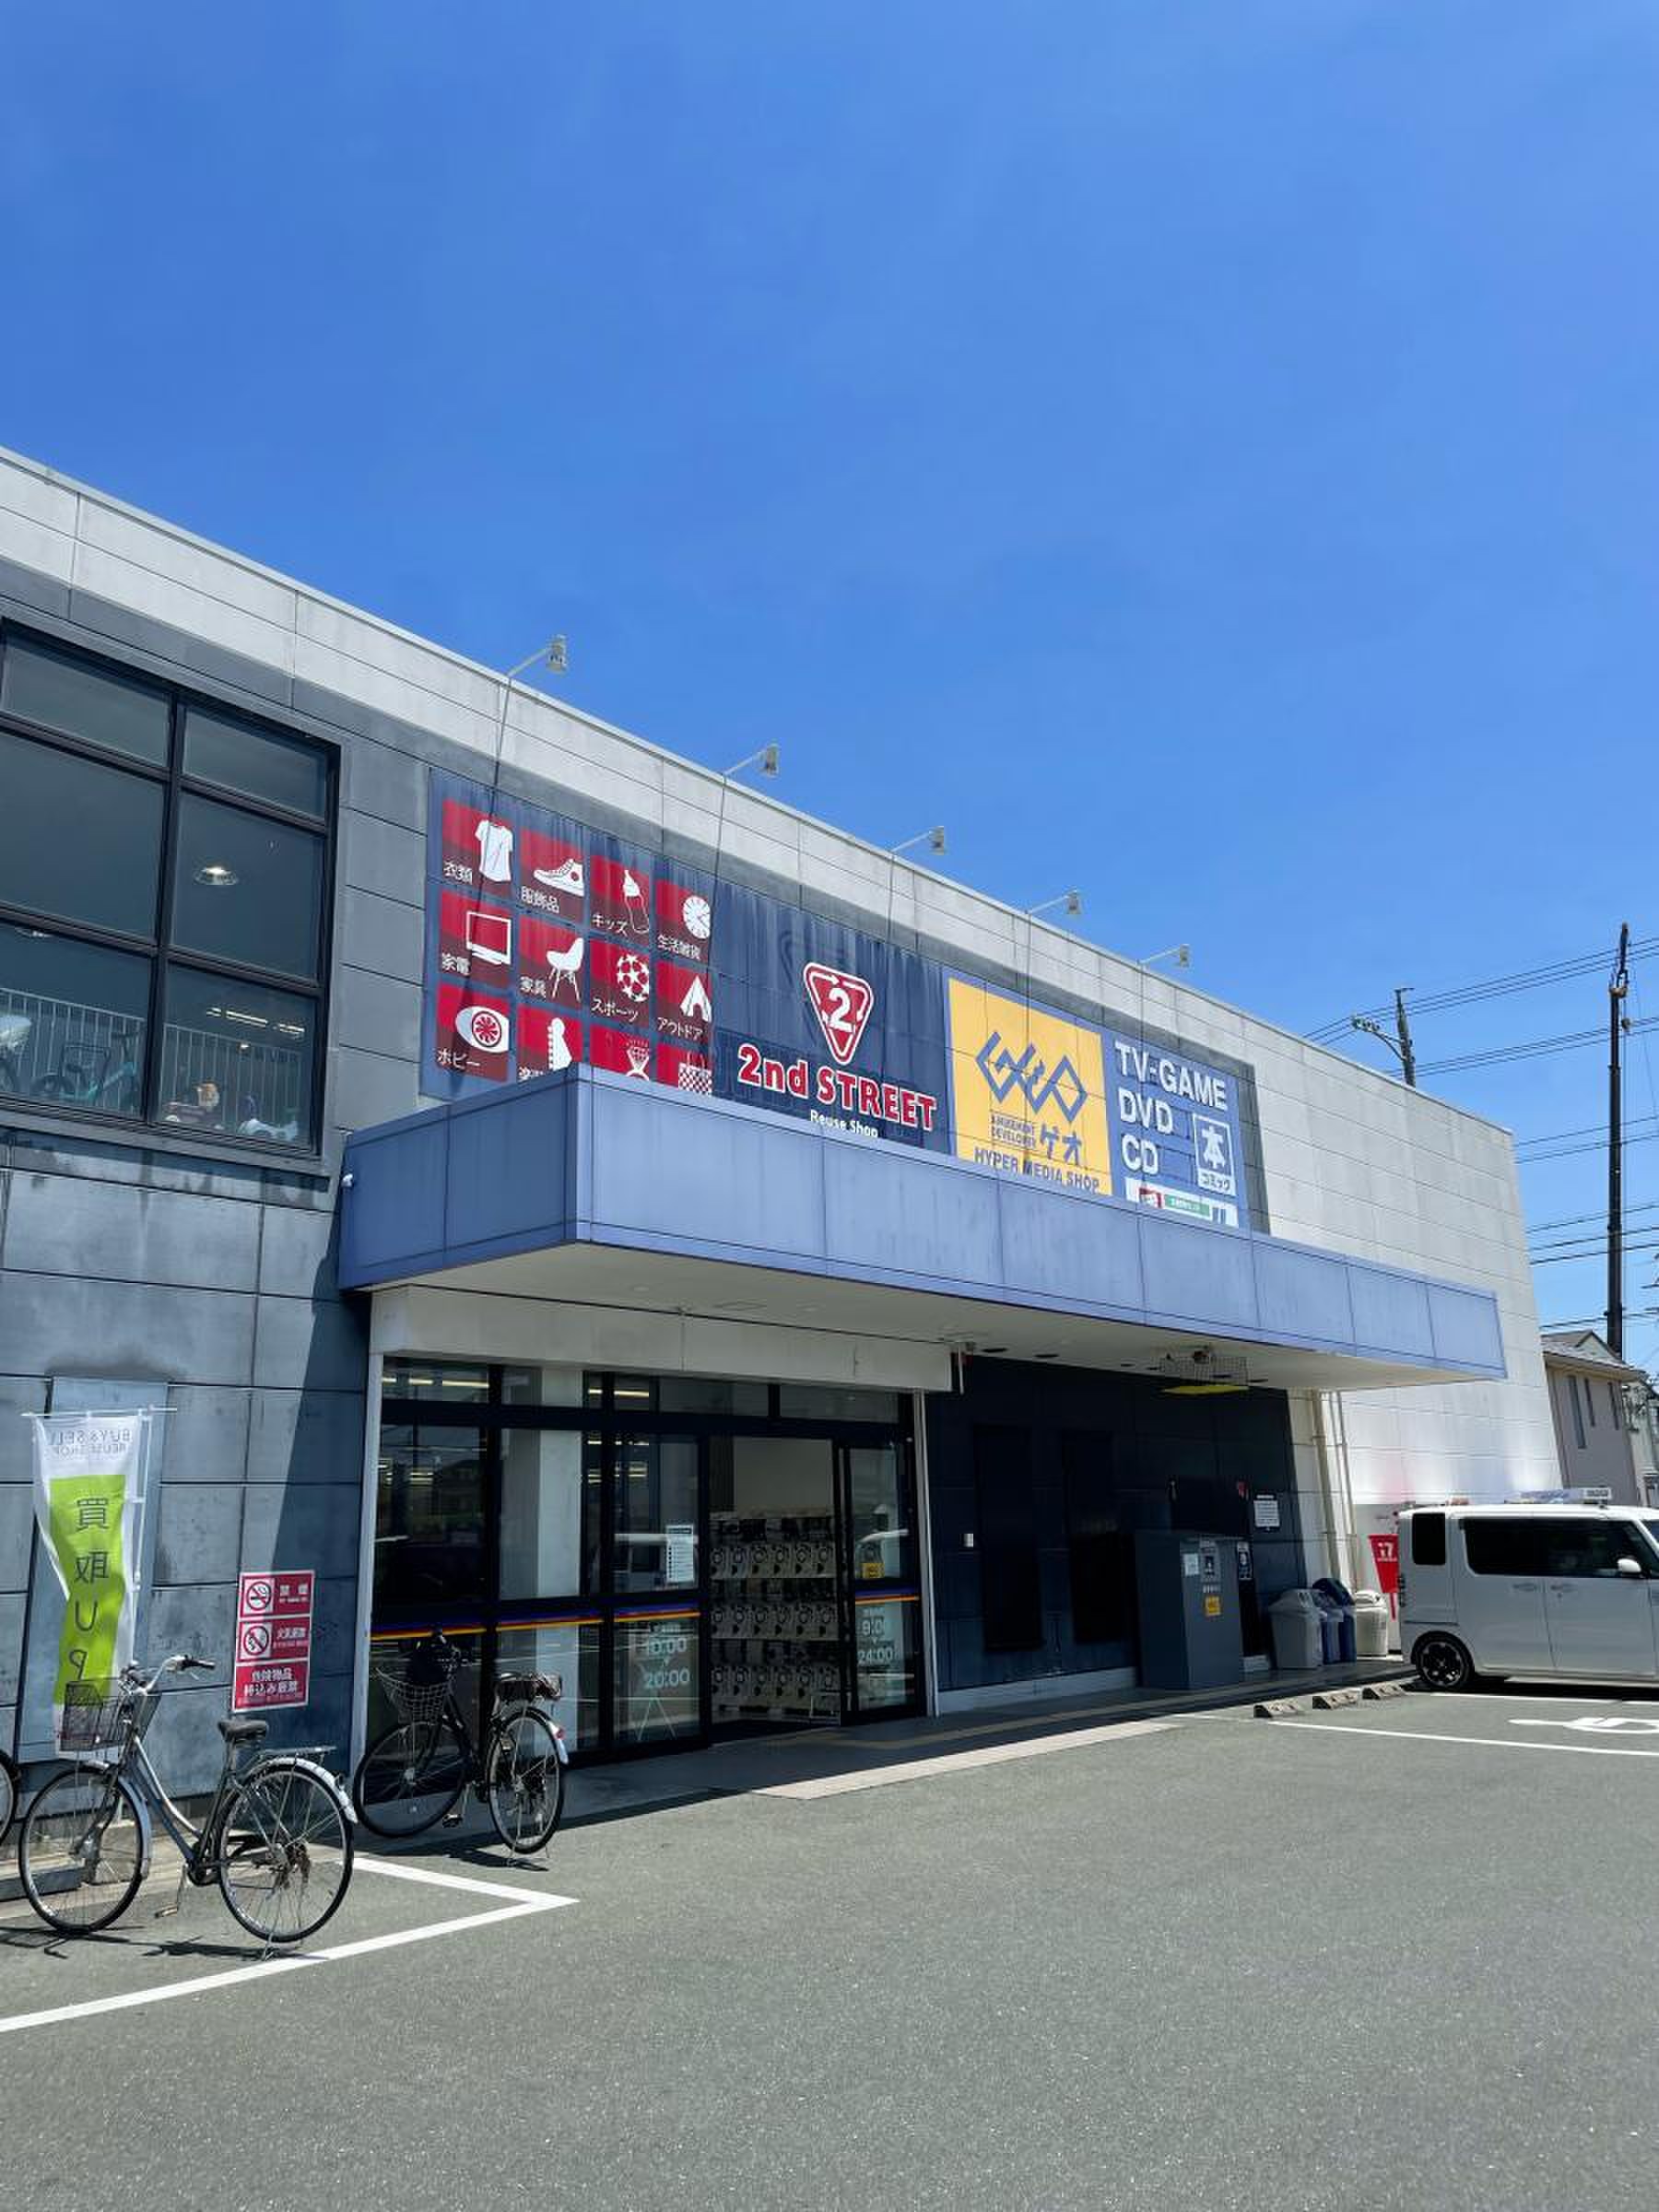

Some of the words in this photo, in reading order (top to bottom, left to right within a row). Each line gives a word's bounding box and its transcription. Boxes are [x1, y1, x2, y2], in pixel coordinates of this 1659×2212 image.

[521, 886, 559, 914] 服飾品
[592, 913, 629, 936] キッズ
[520, 975, 547, 999] 家具
[591, 996, 639, 1022] スポーツ
[828, 986, 855, 1033] 2
[656, 1016, 703, 1041] アウトドア
[437, 1047, 480, 1068] ホビー
[737, 1042, 809, 1100] 2nd
[816, 1065, 937, 1133] STREET
[1114, 1040, 1229, 1112] TV-GAME
[810, 1109, 848, 1132] Reuse
[848, 1118, 879, 1139] Shop
[1118, 1086, 1174, 1135] DVD
[1122, 1134, 1159, 1176] CD
[974, 1147, 1018, 1175] HYPER
[1022, 1159, 1063, 1183] MEDIA
[1065, 1170, 1100, 1194] SHOP
[1200, 1170, 1231, 1194] コミック
